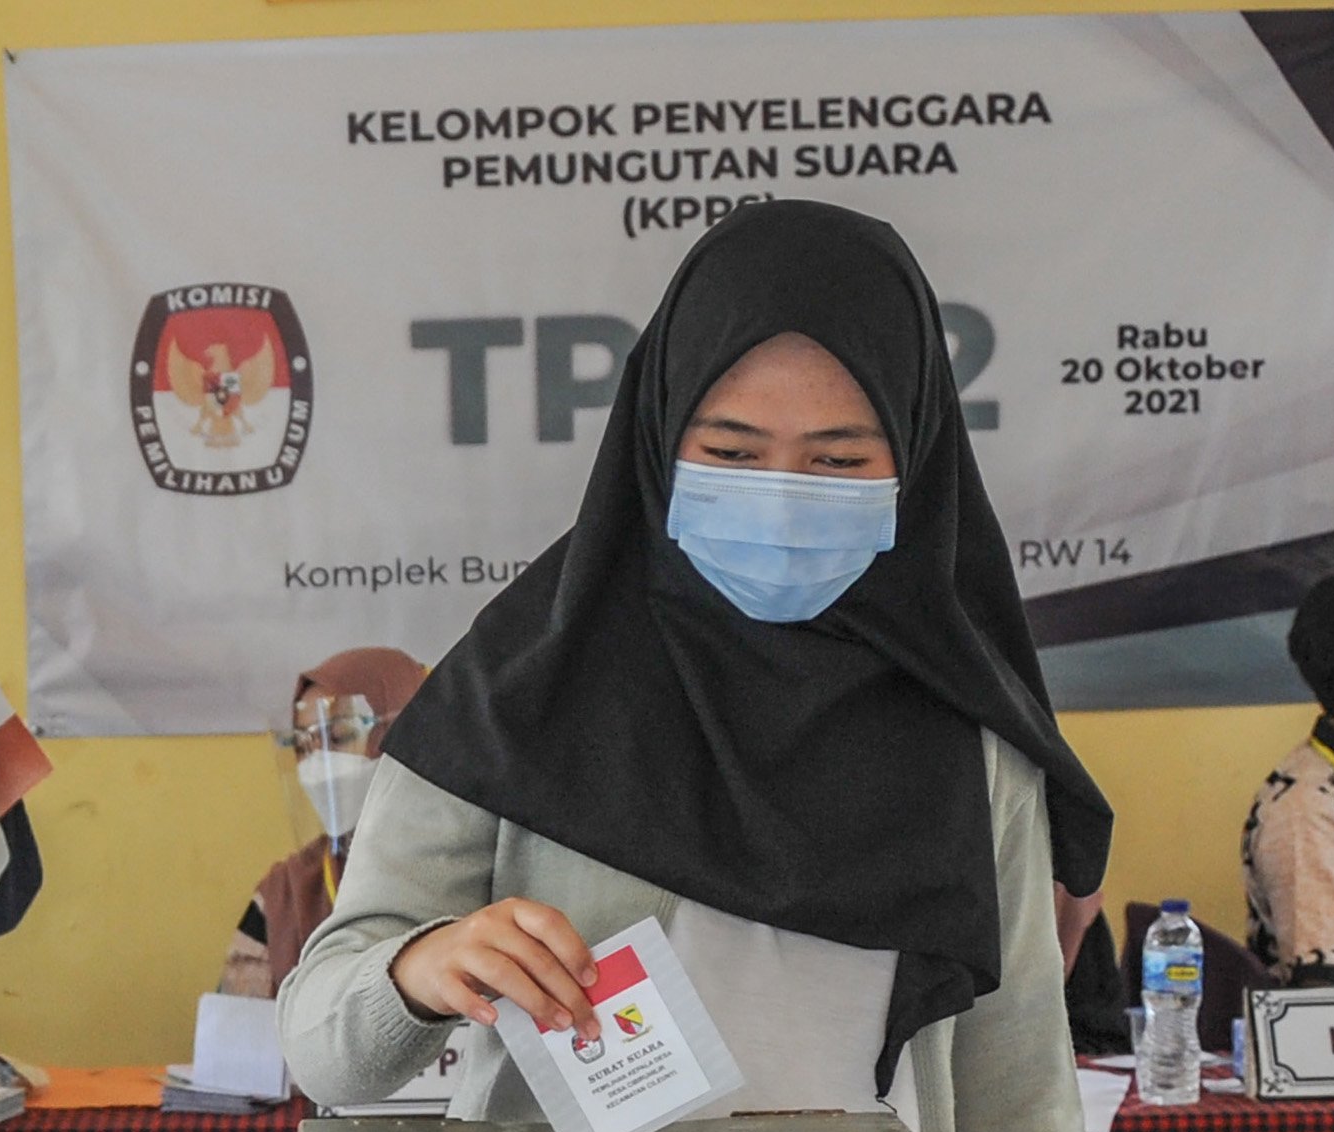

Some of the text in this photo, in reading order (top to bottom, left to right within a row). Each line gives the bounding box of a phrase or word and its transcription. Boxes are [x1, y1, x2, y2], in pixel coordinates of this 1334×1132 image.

[346, 91, 1053, 146] KELOMPOK PENYELENGGARA
[442, 141, 959, 190] PEMUNGUTAN SUARA
[623, 192, 774, 239] (KPP
[166, 285, 273, 312] KOMISI
[1116, 322, 1209, 350] Rabu
[1060, 353, 1265, 384] 20 Oktober
[1123, 388, 1201, 417] 2021
[135, 399, 310, 492] PEMILIHAN UMUM
[1019, 538, 1131, 567] RW 14
[284, 555, 448, 591] Komplek
[587, 1040, 665, 1084] SURAT SUARA
